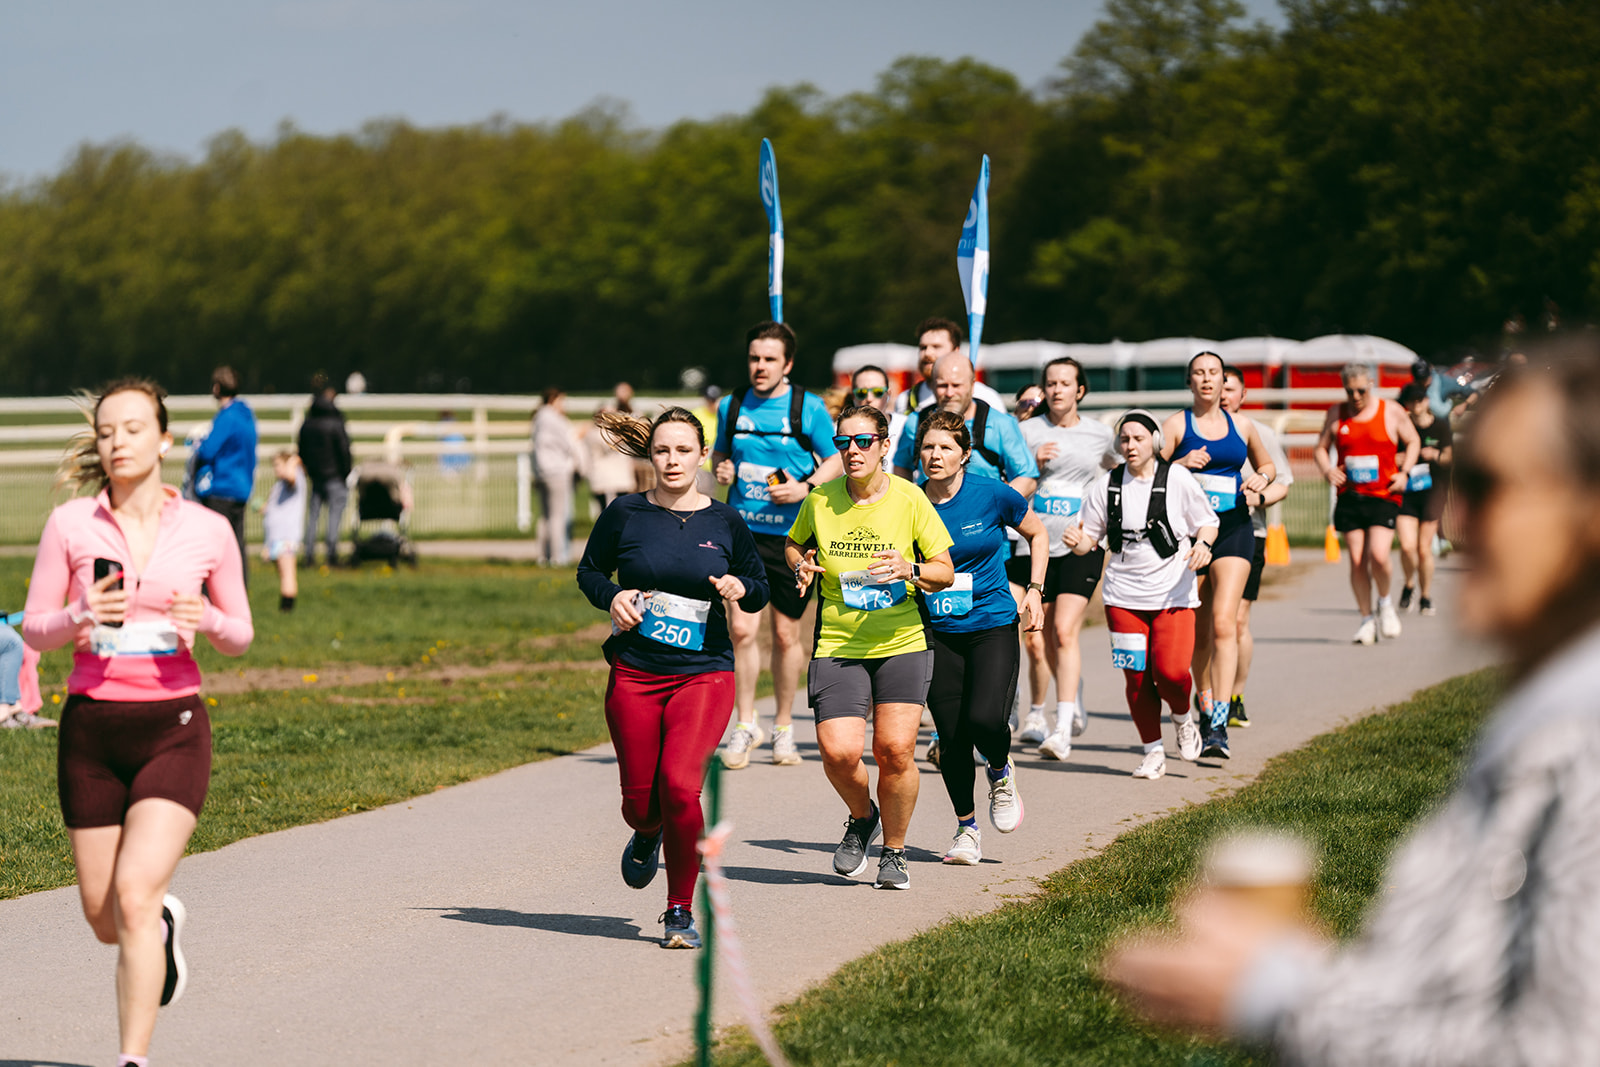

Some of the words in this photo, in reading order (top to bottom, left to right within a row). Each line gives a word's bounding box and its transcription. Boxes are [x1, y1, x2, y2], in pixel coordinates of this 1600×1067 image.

[1044, 499, 1070, 515] 153
[738, 509, 784, 524] PACER
[829, 541, 896, 552] ROTHWELL
[828, 550, 869, 559] HARRIERS
[859, 589, 894, 610] 173
[933, 597, 953, 614] 16
[649, 602, 667, 615] 10k
[650, 620, 692, 646] 250
